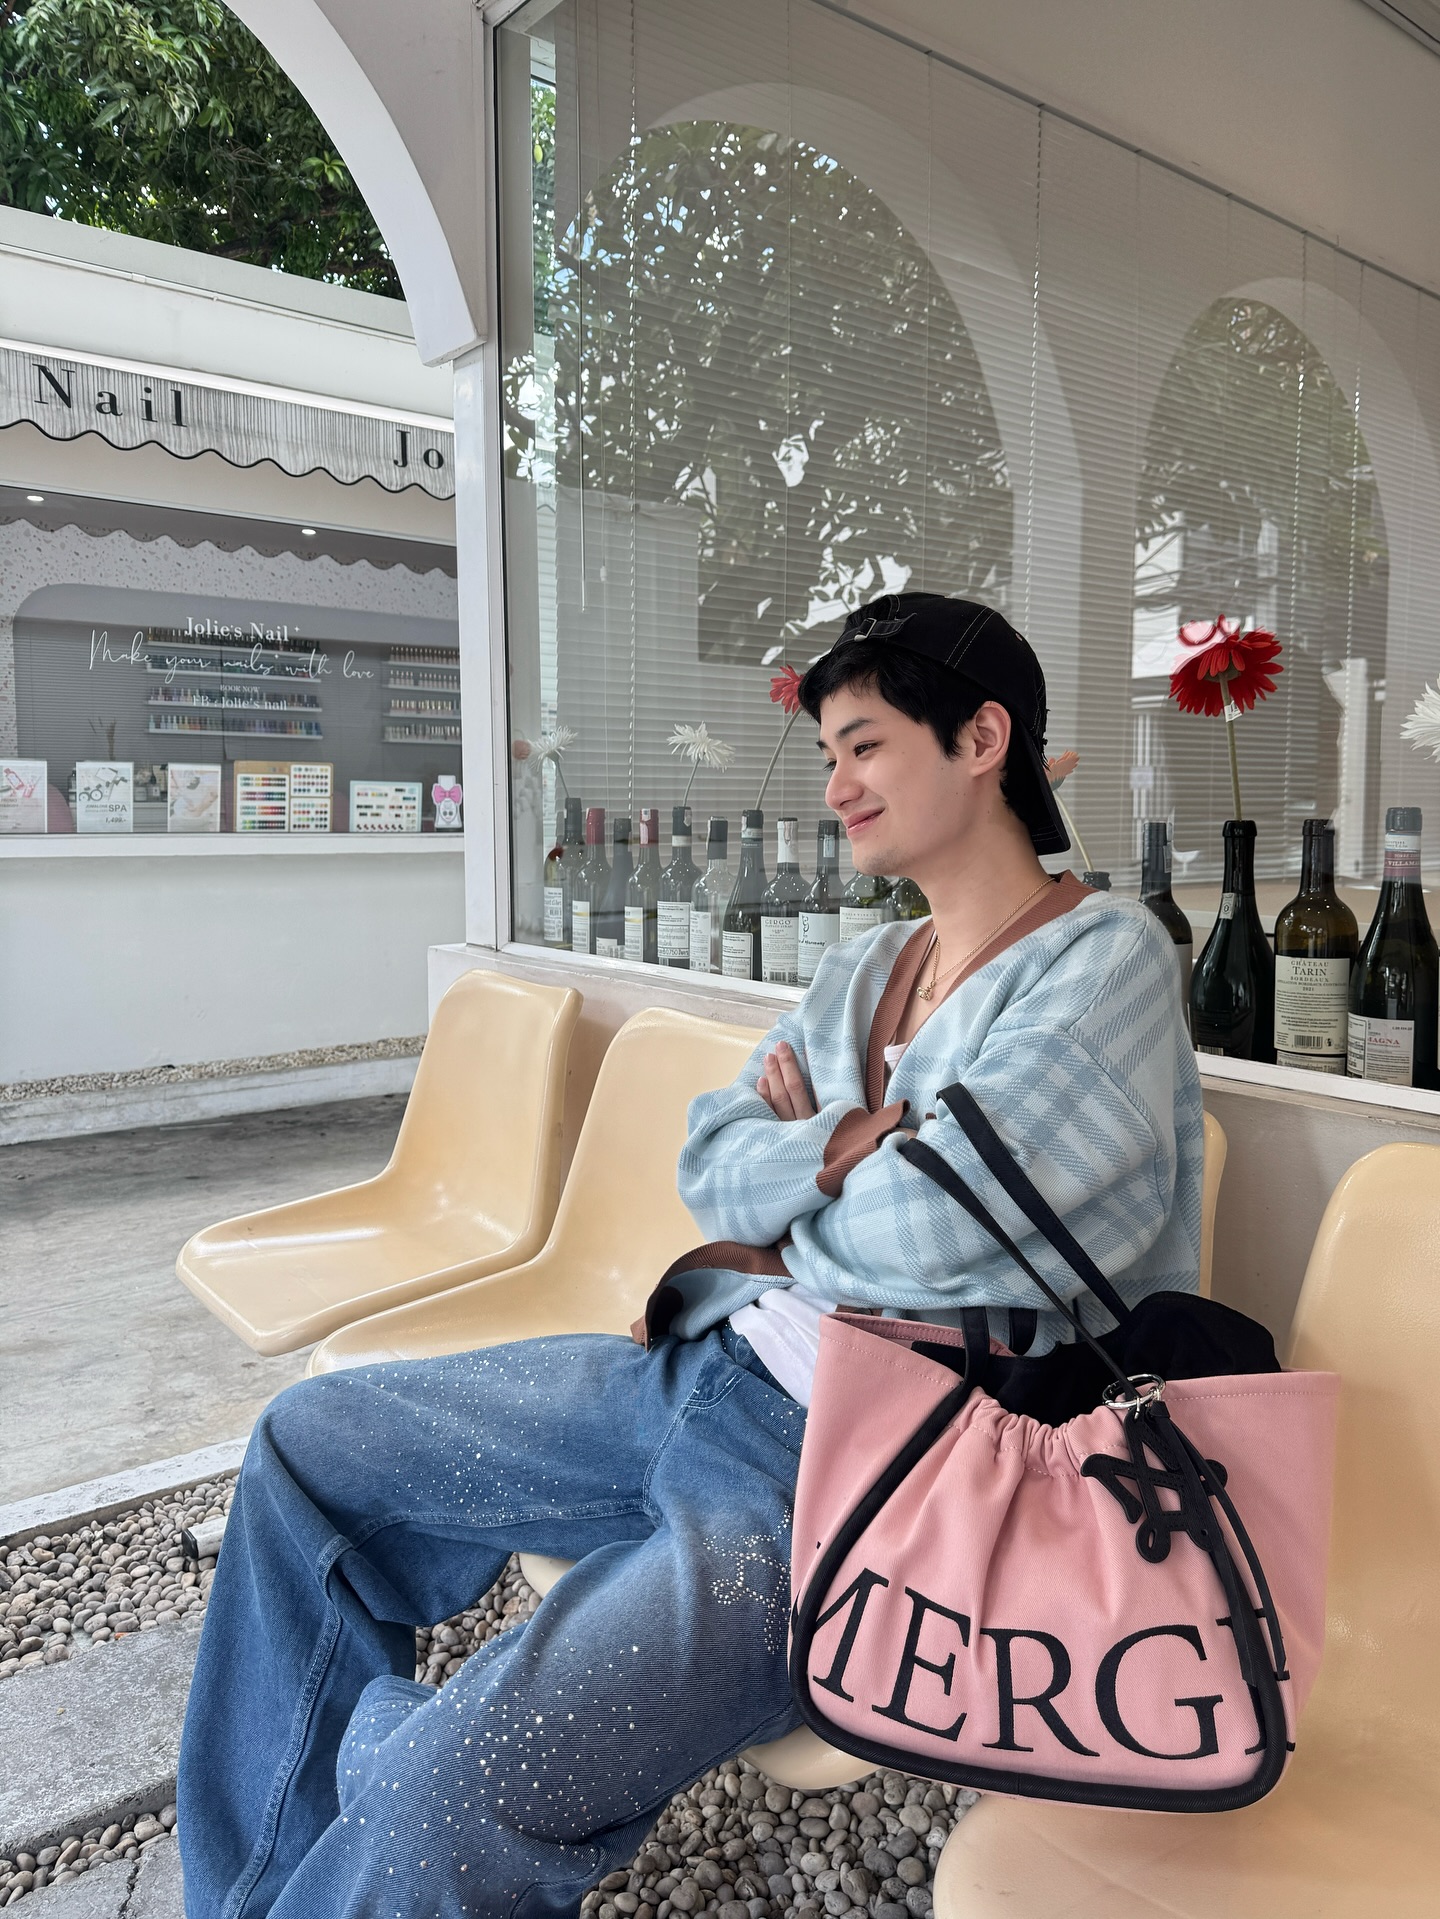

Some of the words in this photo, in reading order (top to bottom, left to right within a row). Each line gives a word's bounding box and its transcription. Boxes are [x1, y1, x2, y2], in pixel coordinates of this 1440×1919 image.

[31, 363, 187, 428] Nail
[393, 429, 445, 470] Jo
[184, 616, 242, 637] Jolie's
[249, 621, 289, 642] Nail
[89, 629, 152, 671] Make
[165, 655, 212, 684] your
[222, 642, 274, 676] nails
[285, 648, 333, 679] with
[342, 649, 375, 679] love
[108, 804, 128, 812] SPA
[1292, 966, 1328, 976] TARIN
